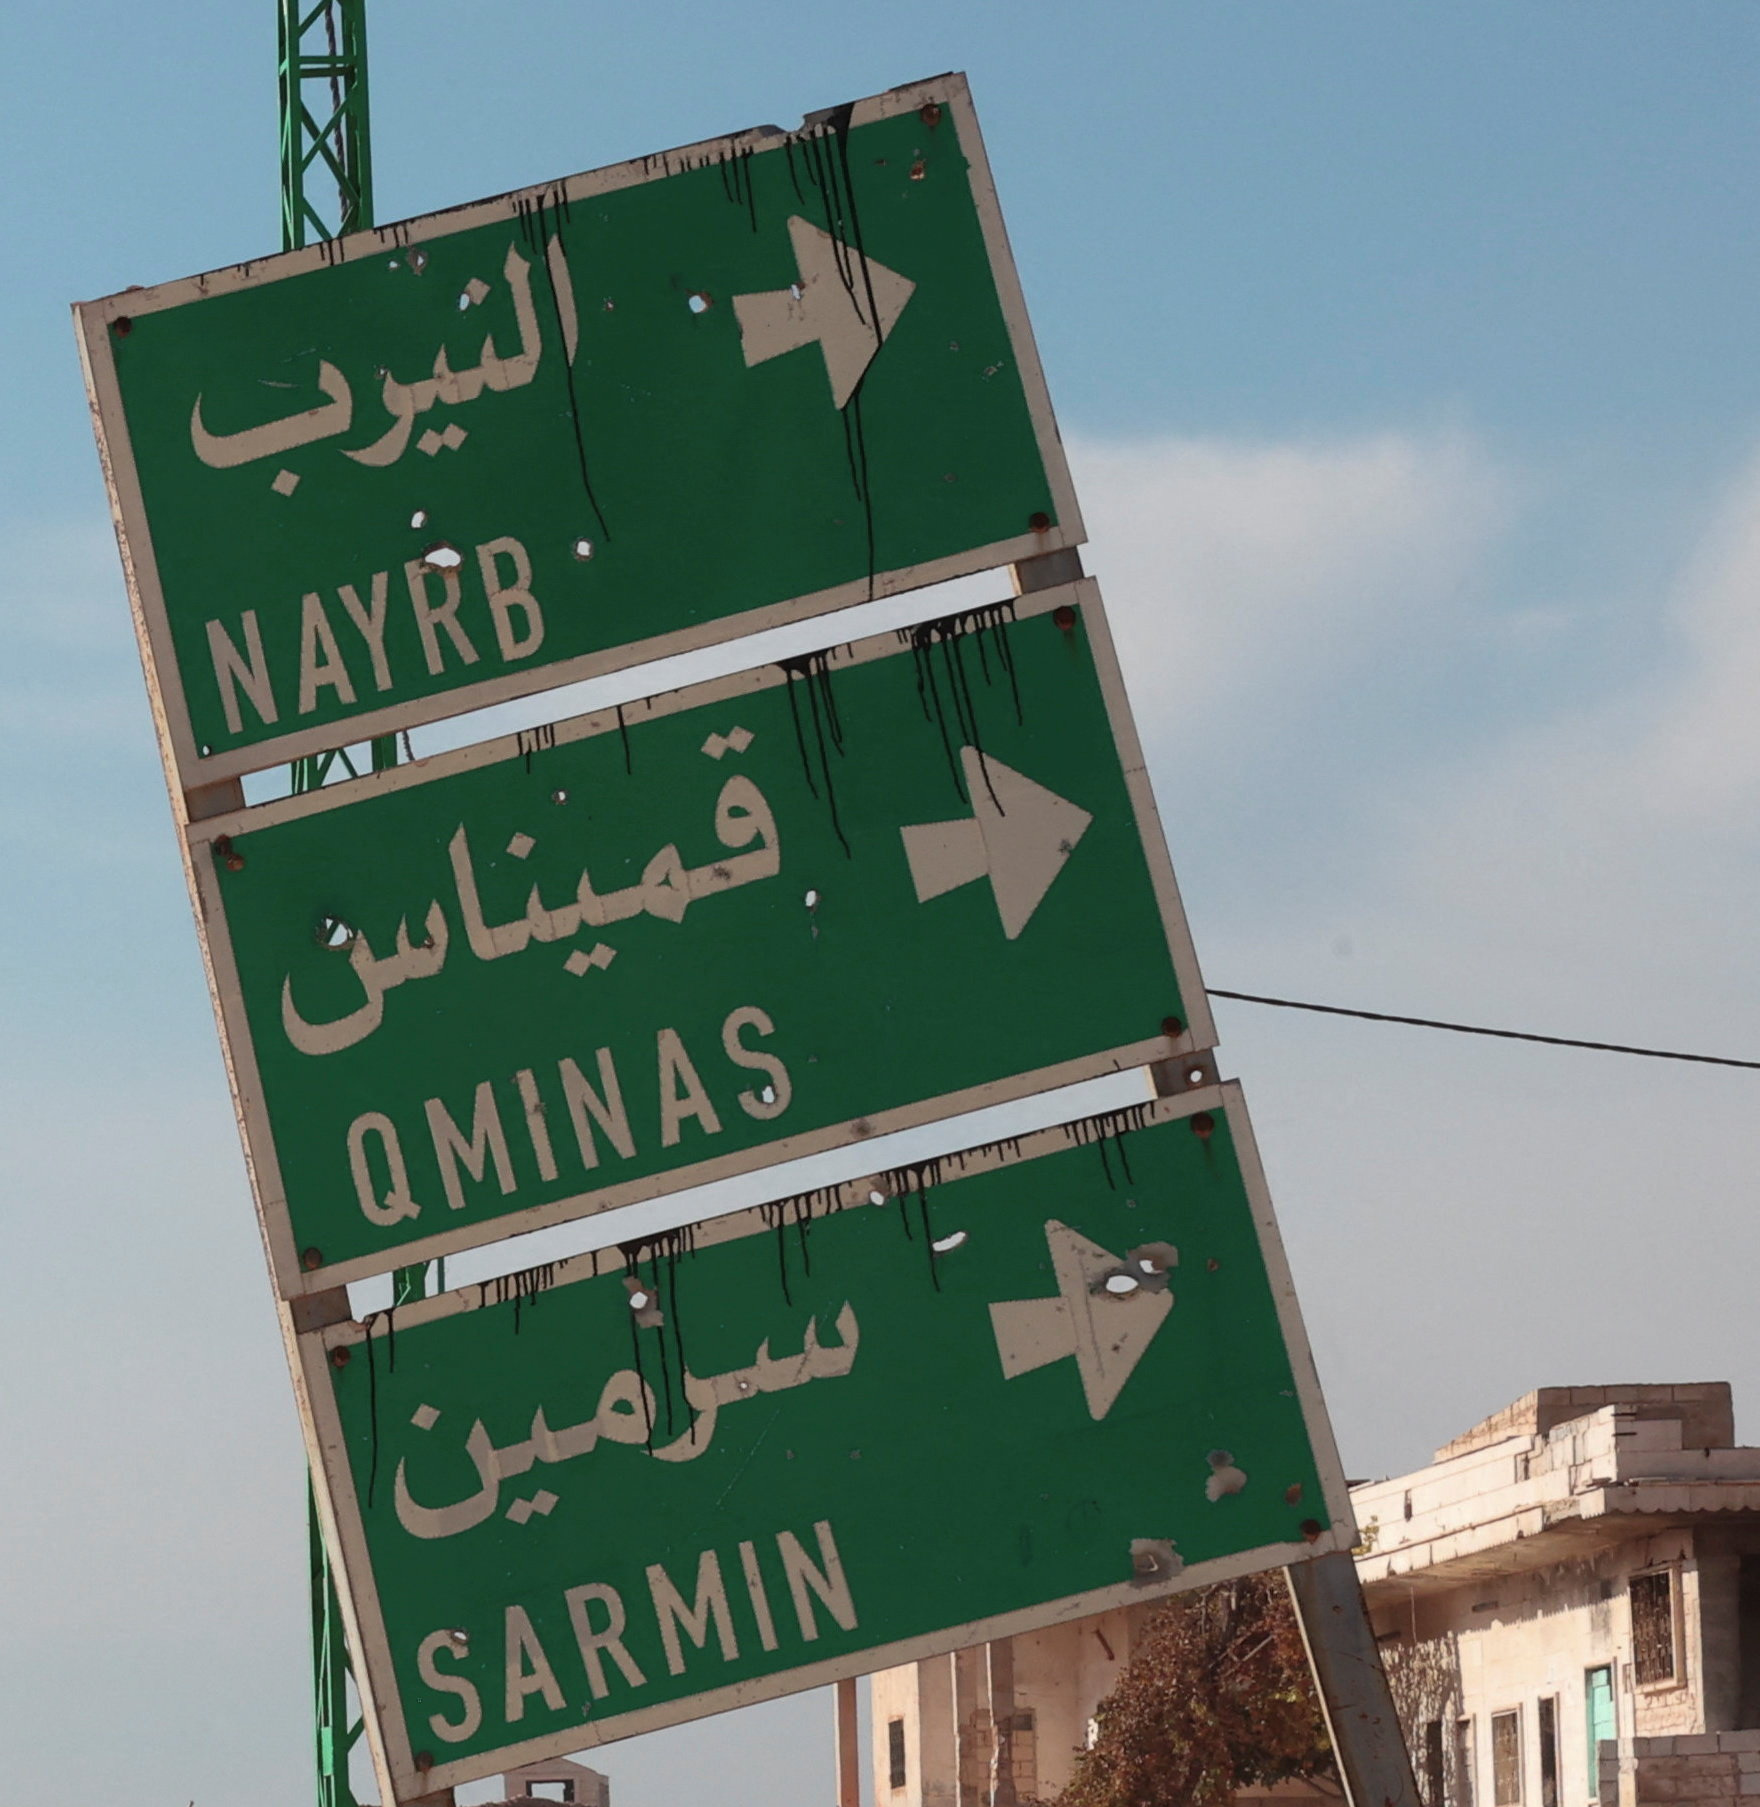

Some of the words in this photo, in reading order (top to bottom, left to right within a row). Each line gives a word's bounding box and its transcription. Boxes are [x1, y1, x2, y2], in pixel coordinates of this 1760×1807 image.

[191, 233, 579, 497] النيرب
[205, 535, 545, 734] NAYRB
[281, 726, 780, 1056] قميناس
[347, 1006, 792, 1227] QMINAS
[394, 1301, 860, 1540] سرمين
[417, 1520, 859, 1744] SARMIN
